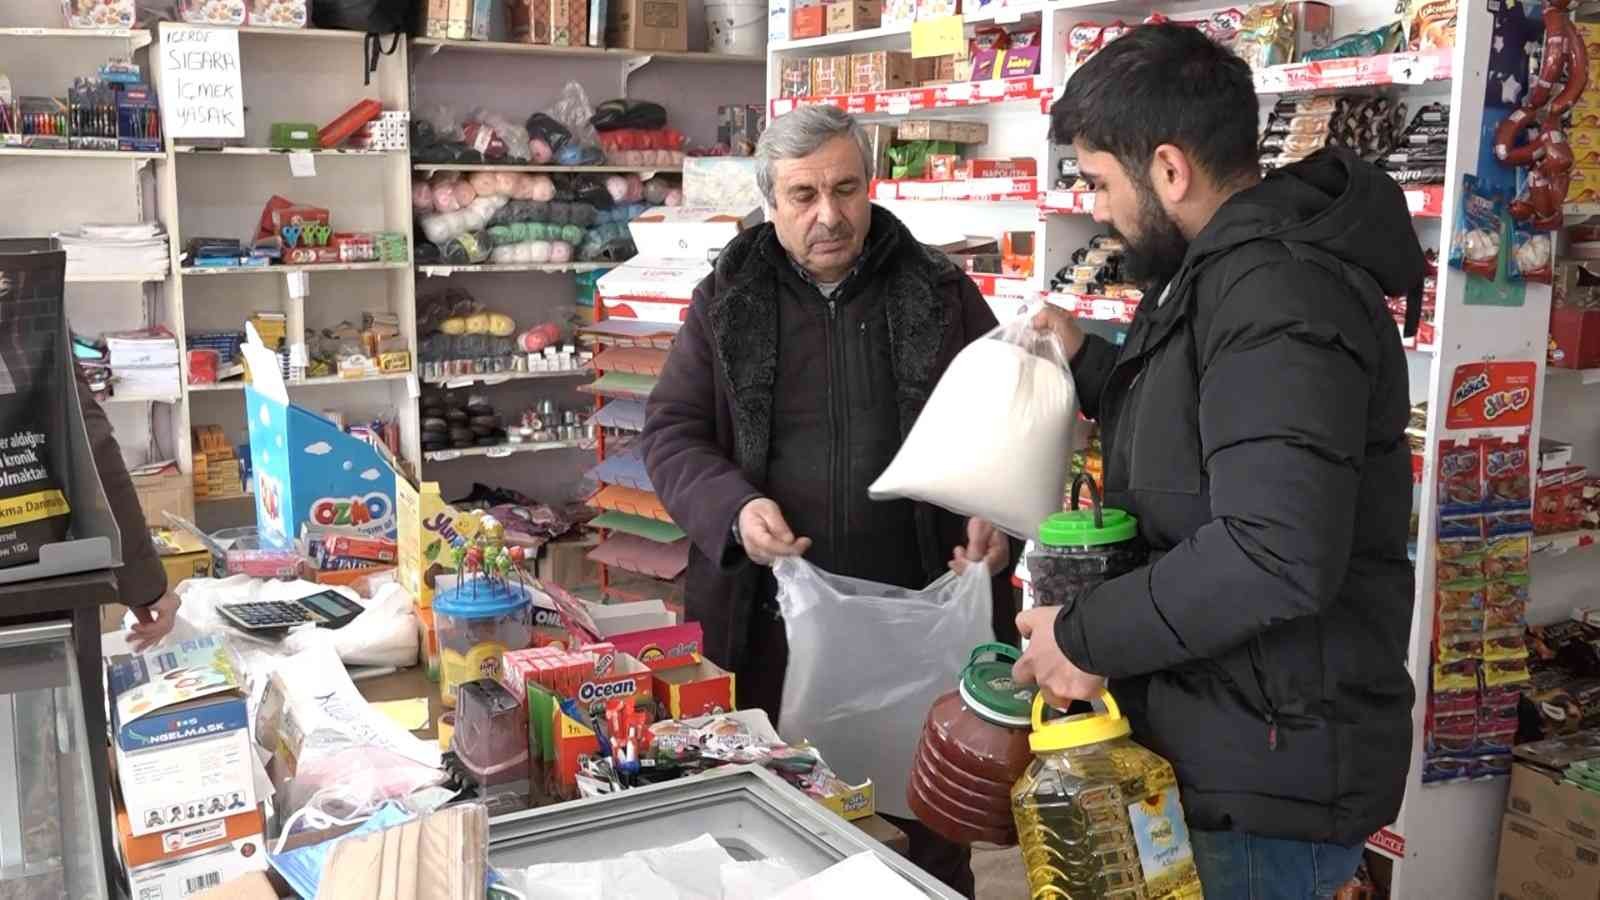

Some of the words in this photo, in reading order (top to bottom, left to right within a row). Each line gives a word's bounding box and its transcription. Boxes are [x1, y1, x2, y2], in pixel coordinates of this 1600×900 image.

[168, 49, 235, 71] SIGARA
[176, 105, 236, 127] YASAK
[2, 449, 39, 466] kronik
[314, 495, 388, 527] OZMO
[580, 679, 636, 700] Ocean
